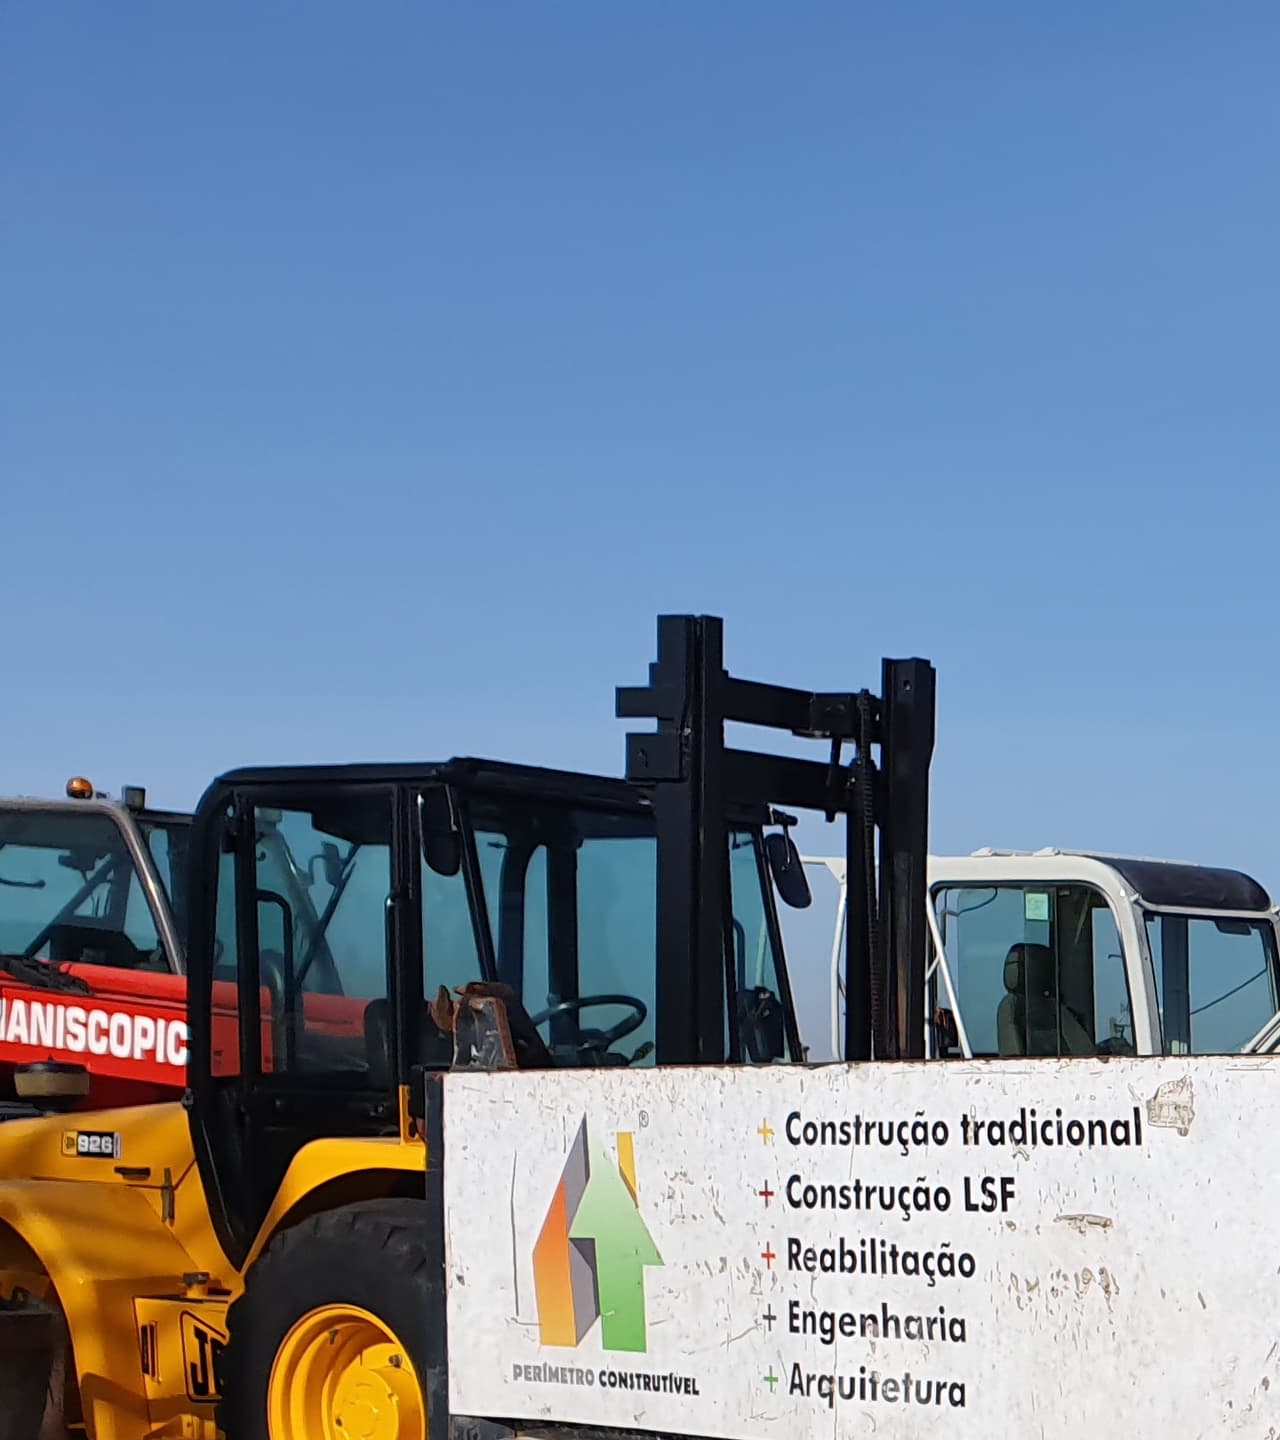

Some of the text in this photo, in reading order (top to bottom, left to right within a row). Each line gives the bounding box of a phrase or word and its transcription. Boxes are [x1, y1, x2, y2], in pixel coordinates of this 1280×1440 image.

[77, 1134, 113, 1154] 926
[785, 1106, 1143, 1156] Construção tradicional
[785, 1173, 1016, 1221] Construção LSF
[787, 1237, 976, 1287] Reabilitação
[788, 1300, 967, 1345] Engenharia
[512, 1362, 700, 1396] PERÍMETRO CONSTRUTÍVEL
[789, 1362, 967, 1408] Arquitetura
